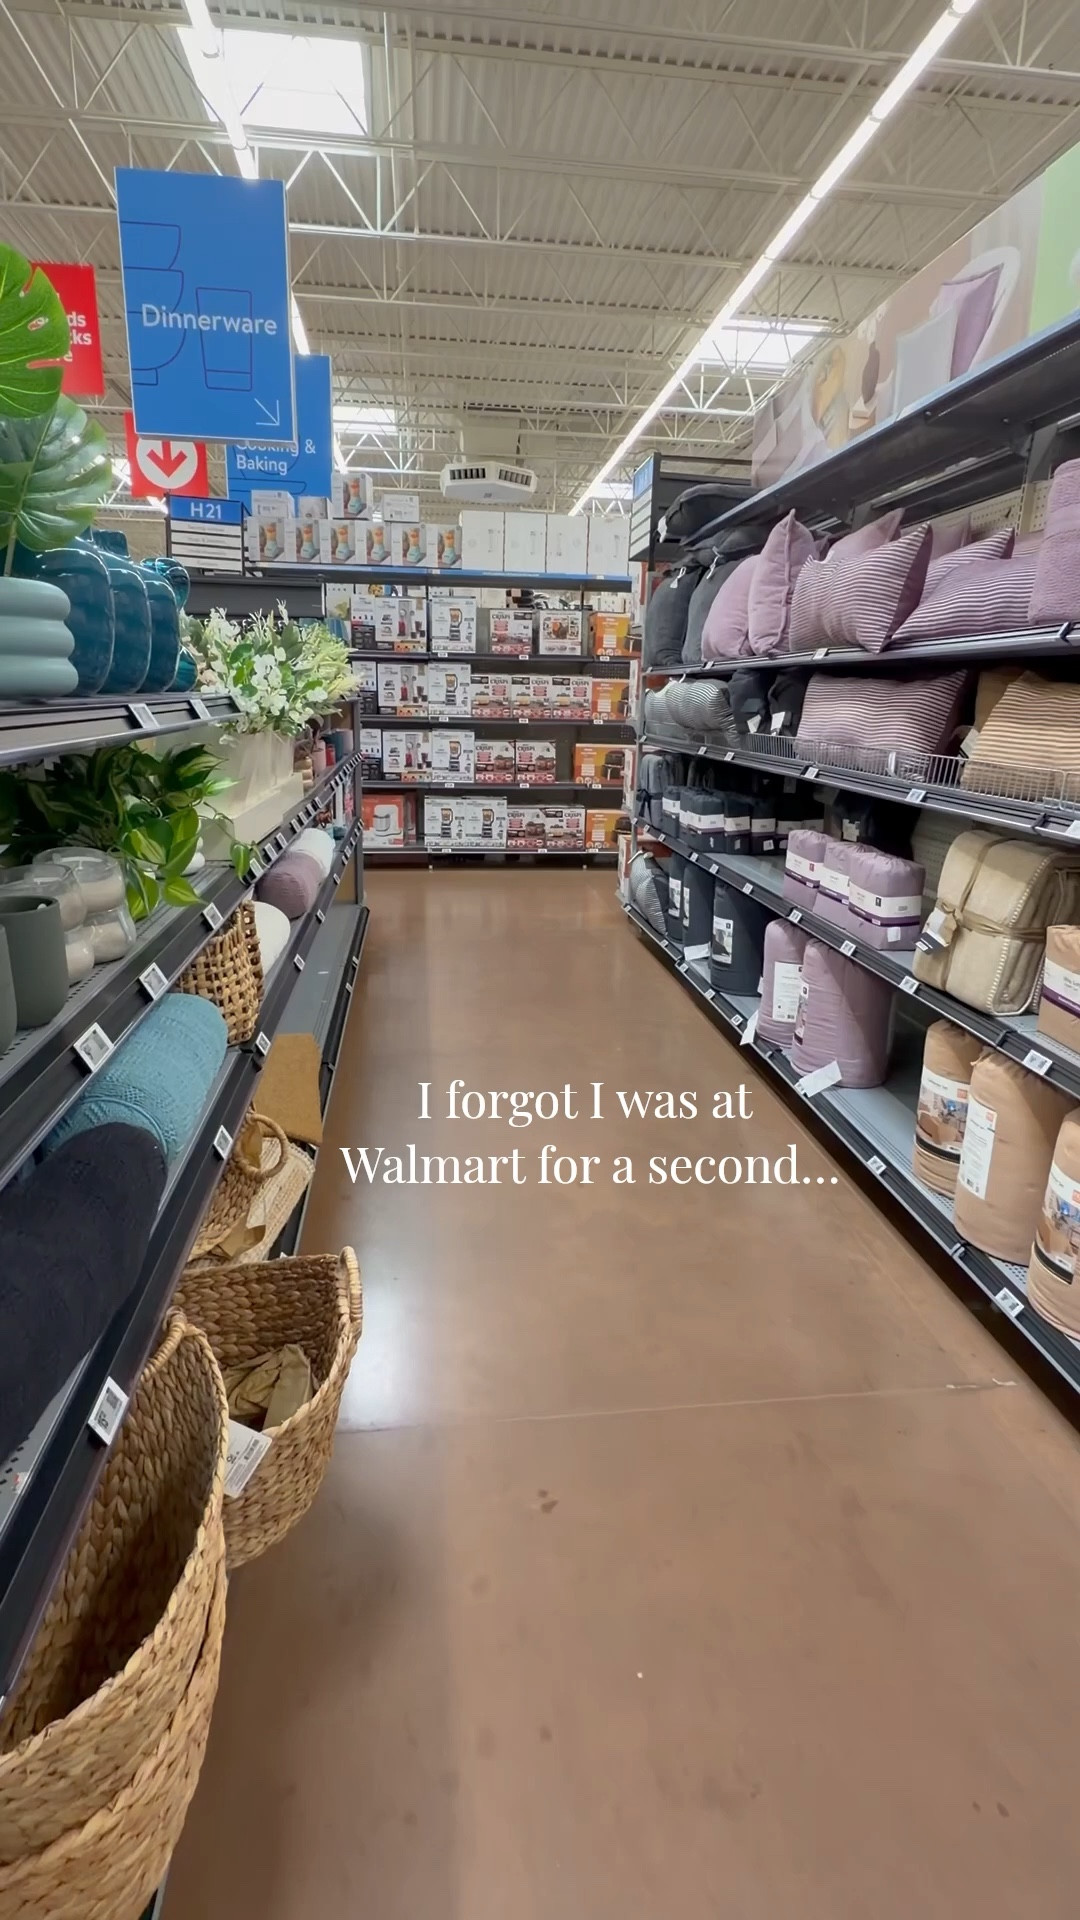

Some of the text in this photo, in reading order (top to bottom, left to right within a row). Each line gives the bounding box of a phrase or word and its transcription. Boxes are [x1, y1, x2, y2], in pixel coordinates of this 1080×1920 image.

[142, 303, 278, 335] Dinnerware
[304, 438, 316, 455] &
[236, 454, 288, 476] Baking
[190, 502, 222, 519] H21
